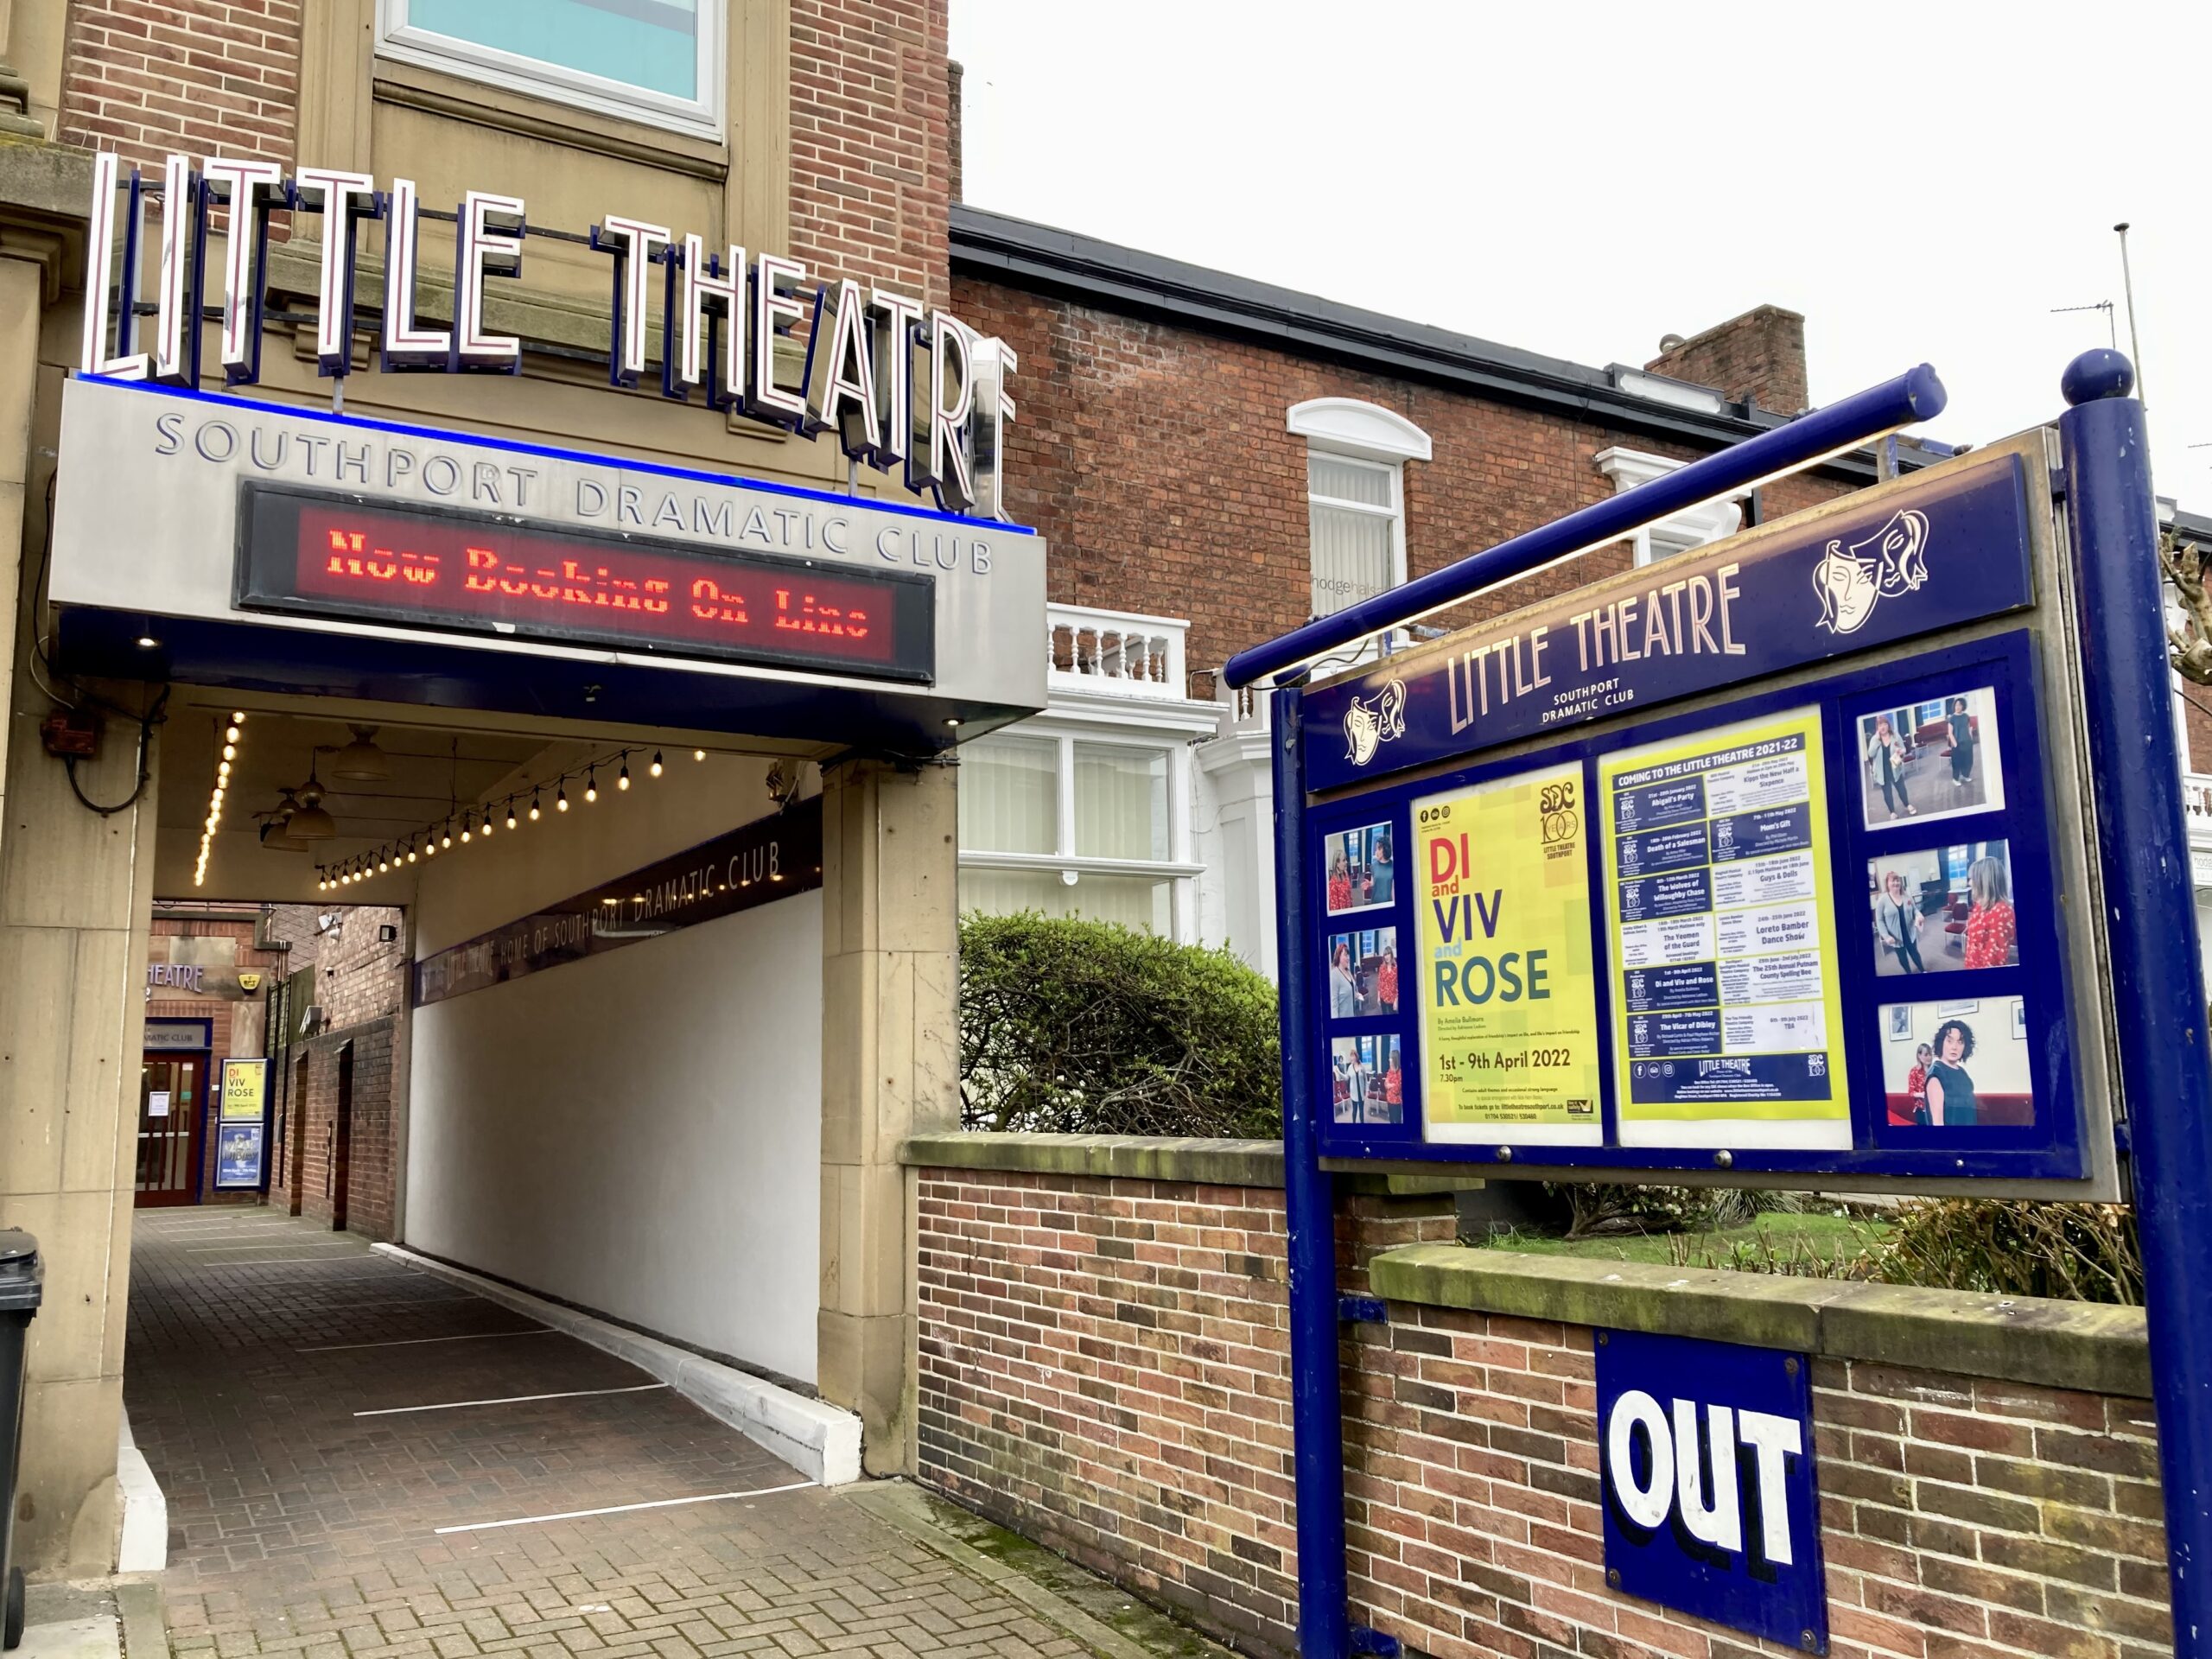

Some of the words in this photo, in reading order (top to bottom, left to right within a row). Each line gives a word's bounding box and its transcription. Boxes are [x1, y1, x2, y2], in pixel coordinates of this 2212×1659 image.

[82, 153, 524, 381] LITTLE
[604, 215, 1018, 524] THEATRE
[156, 412, 537, 506] SOUTHPORT
[576, 478, 849, 555] DRAMATIC
[877, 526, 993, 575] CLUB
[327, 531, 440, 584] Now
[692, 579, 748, 623] On
[1447, 625, 1551, 735] LITTLE
[1569, 563, 1745, 672] THEATRE
[1554, 677, 1620, 706] SOUTHPORT
[1541, 699, 1599, 723] DRAMATIC
[1605, 690, 1635, 706] CLUB
[1618, 770, 1651, 786] COMING
[1652, 767, 1662, 779] TO
[1664, 763, 1682, 776] THE
[1682, 757, 1710, 772] LITTLE
[1712, 747, 1754, 766] THEATRE
[1756, 737, 1797, 756] 2021-22
[1743, 774, 1758, 784] Kipps
[1759, 777, 1783, 788] Sixpence
[1651, 794, 1676, 808] Abigail's
[1677, 791, 1694, 803] Party
[1760, 822, 1779, 831] Mom's
[1646, 843, 1664, 853] Death
[1678, 836, 1705, 847] Salesman
[1429, 832, 1470, 884] DI
[1431, 874, 1459, 897] and
[1669, 880, 1691, 890] Wolves
[1759, 873, 1775, 883] Guys
[1783, 869, 1797, 878] Dolls
[501, 935, 528, 964] HOME
[534, 926, 548, 954] OF
[555, 899, 625, 948] SOUTHPORT
[634, 864, 715, 923] DRAMATIC
[728, 842, 779, 890] CLUB
[1653, 890, 1686, 902] Willoughby
[1686, 887, 1705, 897] Chase
[1433, 888, 1503, 944] VIV
[1756, 924, 1779, 933] Loreto
[1781, 920, 1808, 931] Bamber
[1762, 934, 1783, 944] Dance
[1784, 931, 1805, 941] Show
[1433, 938, 1462, 958] and
[1435, 949, 1551, 1007] ROSE
[1780, 969, 1800, 978] Spelling
[1696, 1020, 1715, 1029] Dibley
[171, 1033, 193, 1042] CLUB
[1439, 1053, 1456, 1071] 1st
[1467, 1052, 1491, 1070] 9th
[1494, 1051, 1529, 1072] April
[1532, 1048, 1571, 1067] 2022
[1699, 1059, 1720, 1077] LITTLE
[1720, 1058, 1751, 1076] THEATRE
[229, 1068, 238, 1077] DI
[1440, 1074, 1463, 1084] 7.30pm
[1609, 1389, 1802, 1565] OUT
